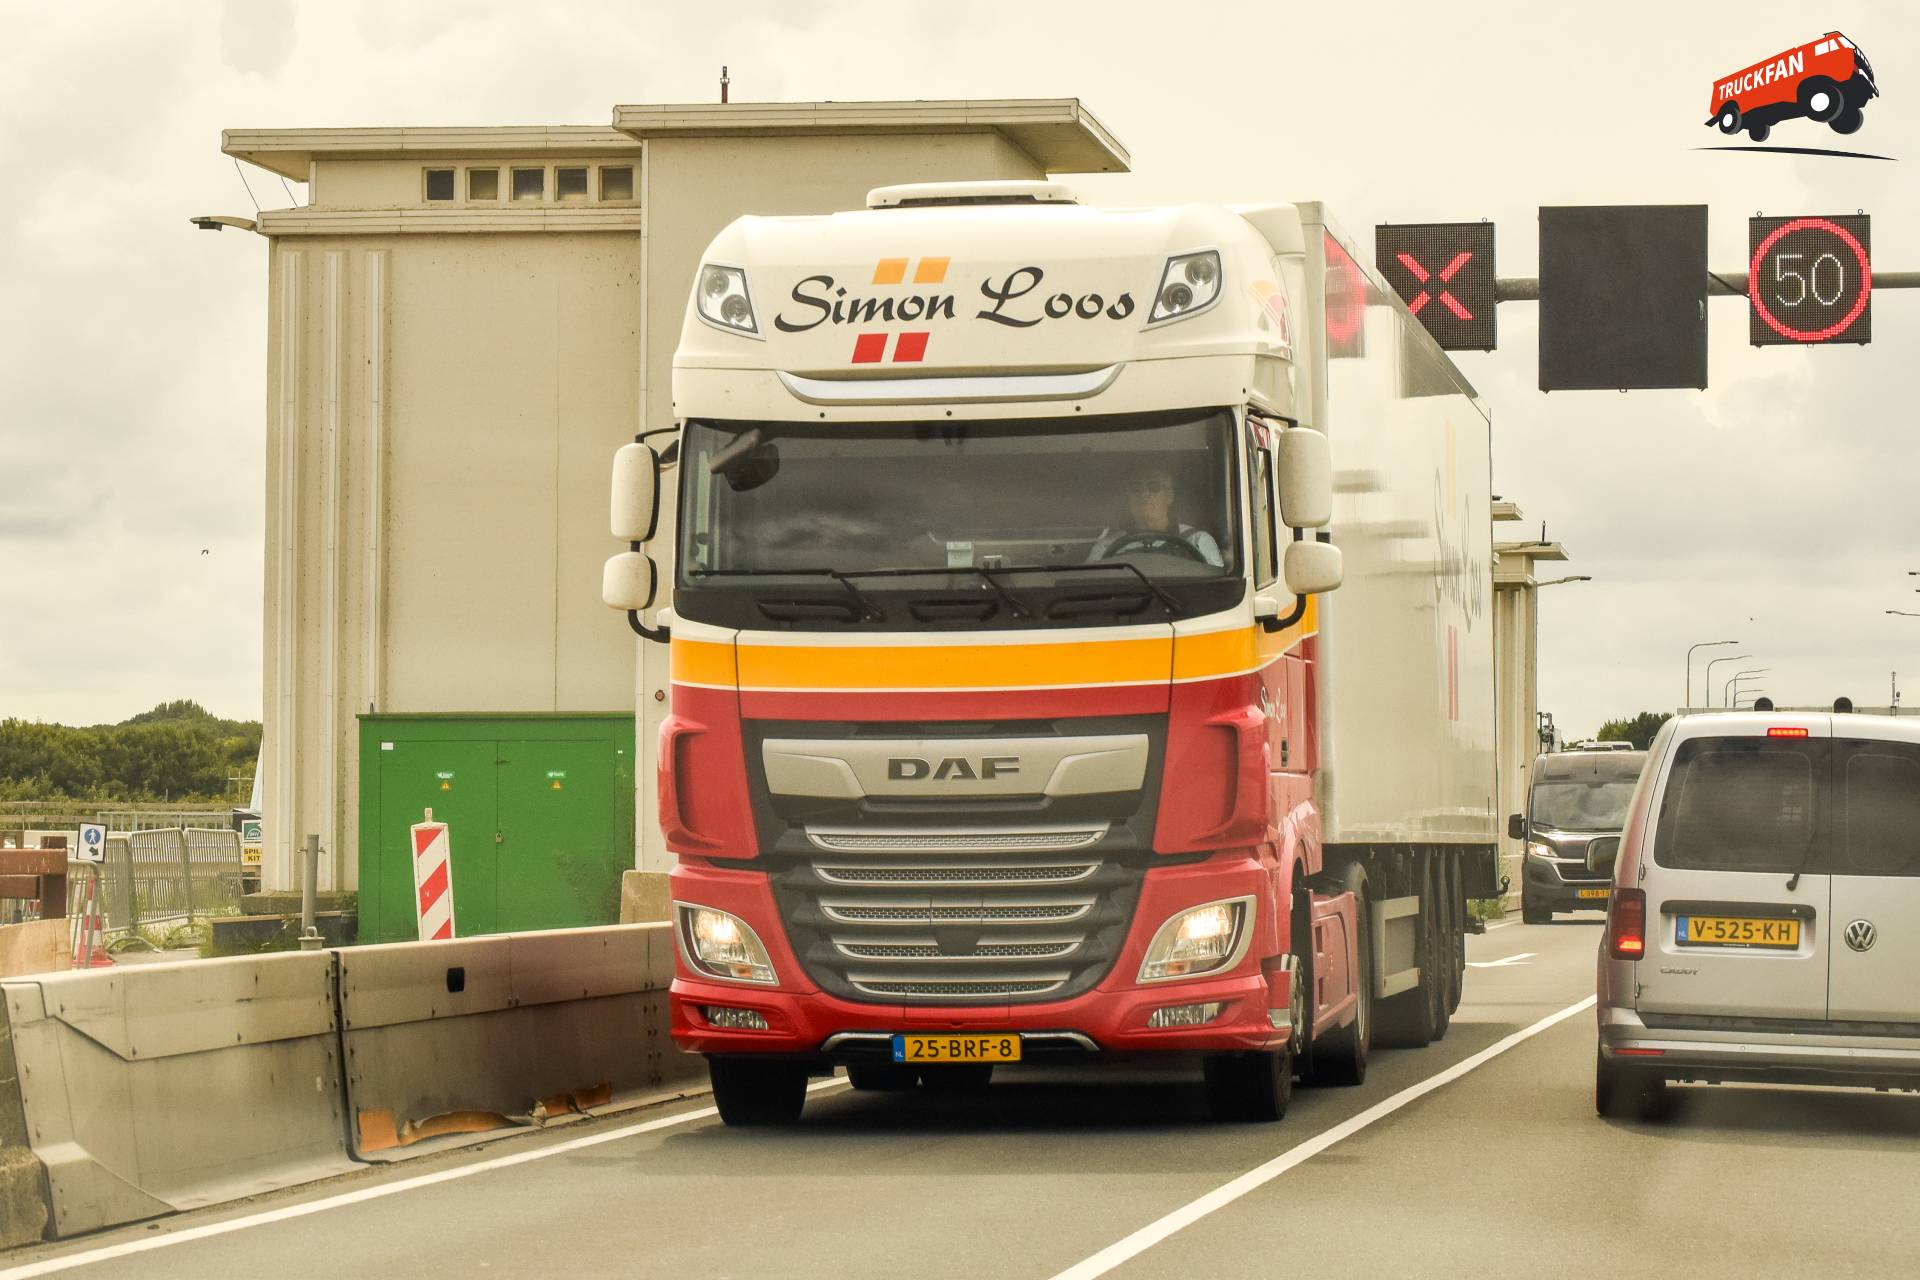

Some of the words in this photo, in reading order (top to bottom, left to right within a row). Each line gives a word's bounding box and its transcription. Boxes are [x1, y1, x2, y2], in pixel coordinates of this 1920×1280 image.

[1776, 253, 1843, 306] 50
[774, 275, 956, 333] Simon
[975, 266, 1135, 328] Loos
[888, 756, 1021, 780] DAF
[1693, 919, 1791, 942] V-525-KH
[895, 1050, 905, 1058] NL
[912, 1038, 1013, 1058] 25-BRF-8
